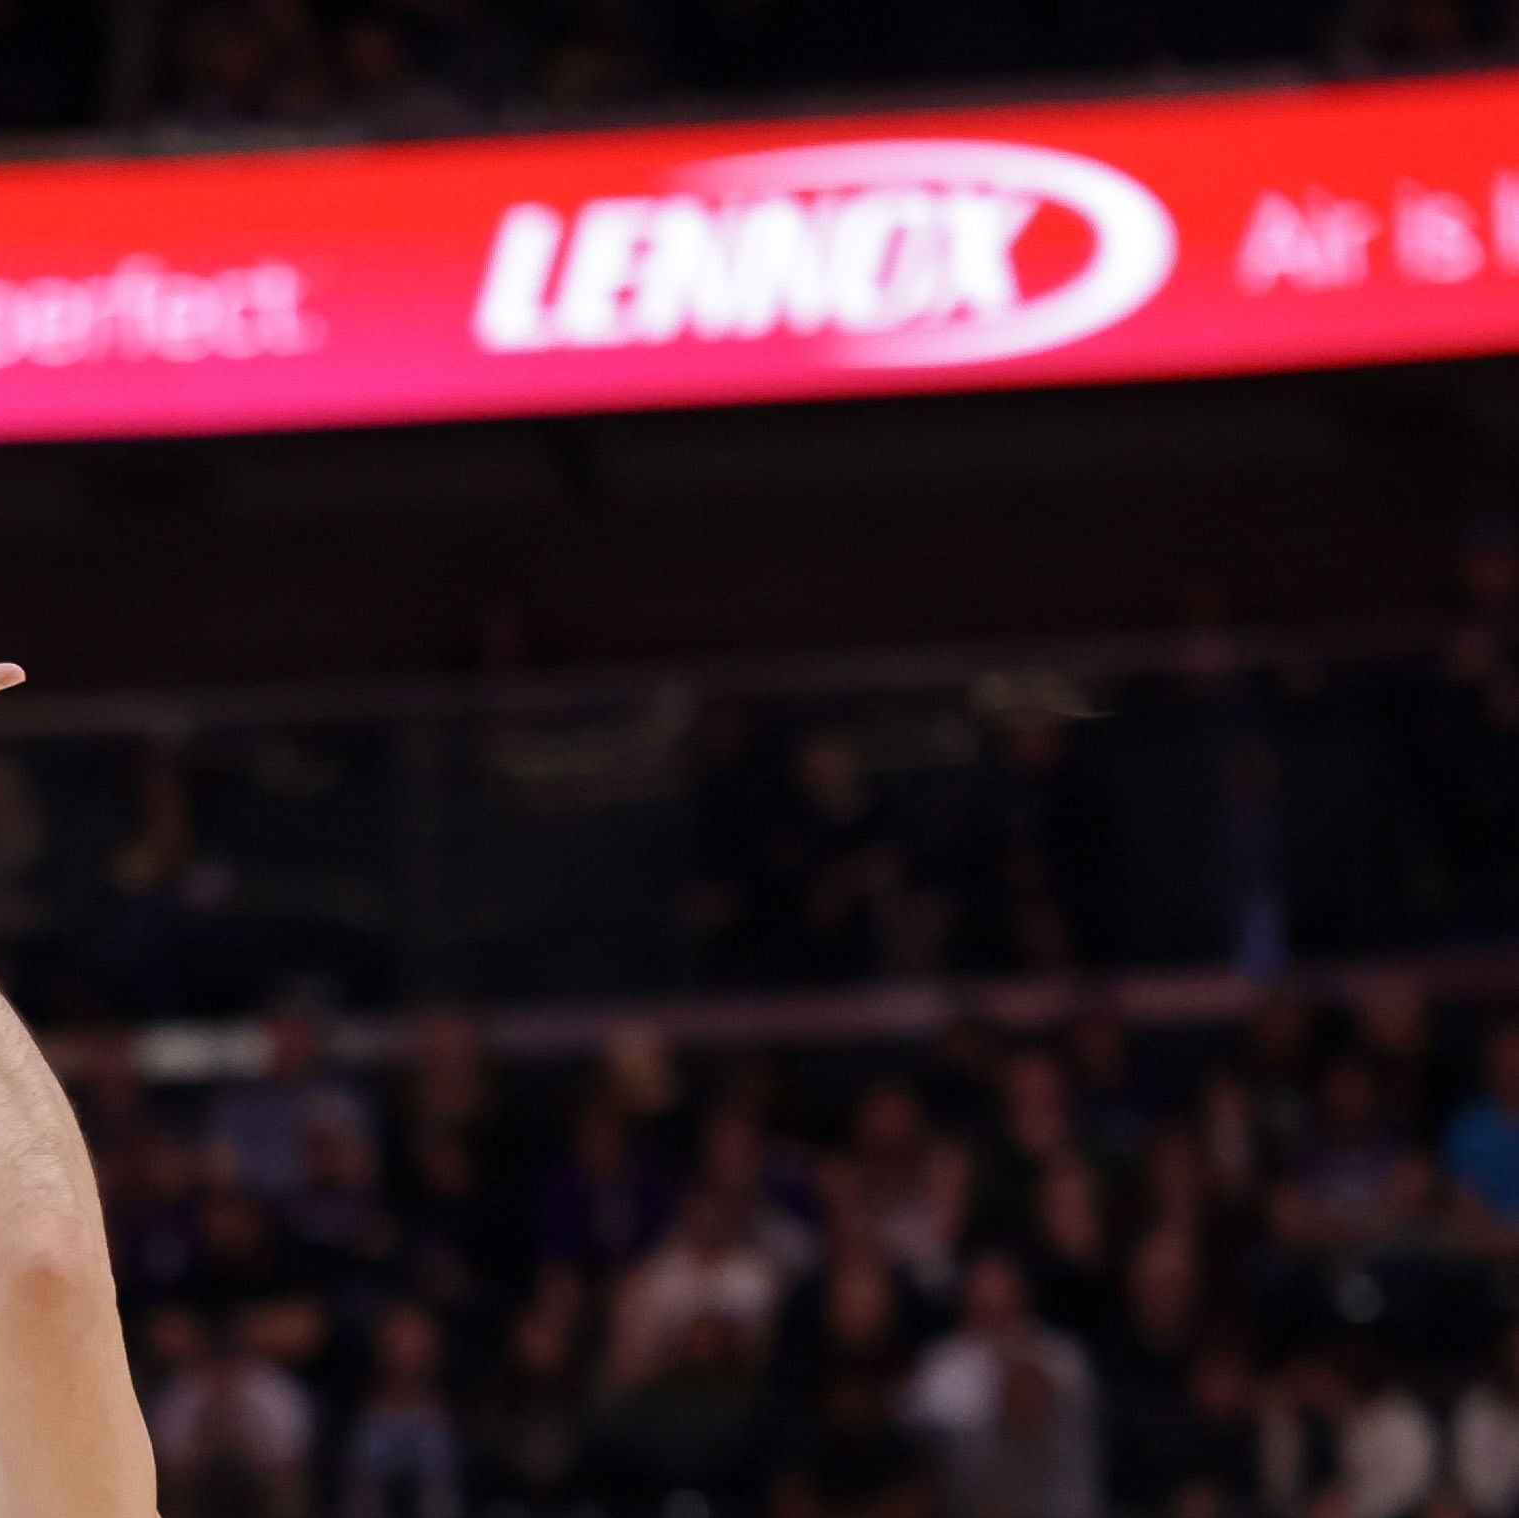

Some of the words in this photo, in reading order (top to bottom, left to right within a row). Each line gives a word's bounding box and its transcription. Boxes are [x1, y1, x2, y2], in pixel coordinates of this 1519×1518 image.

[473, 195, 1043, 355] LENNOX
[1233, 188, 1383, 297] Air
[1391, 176, 1486, 285] is
